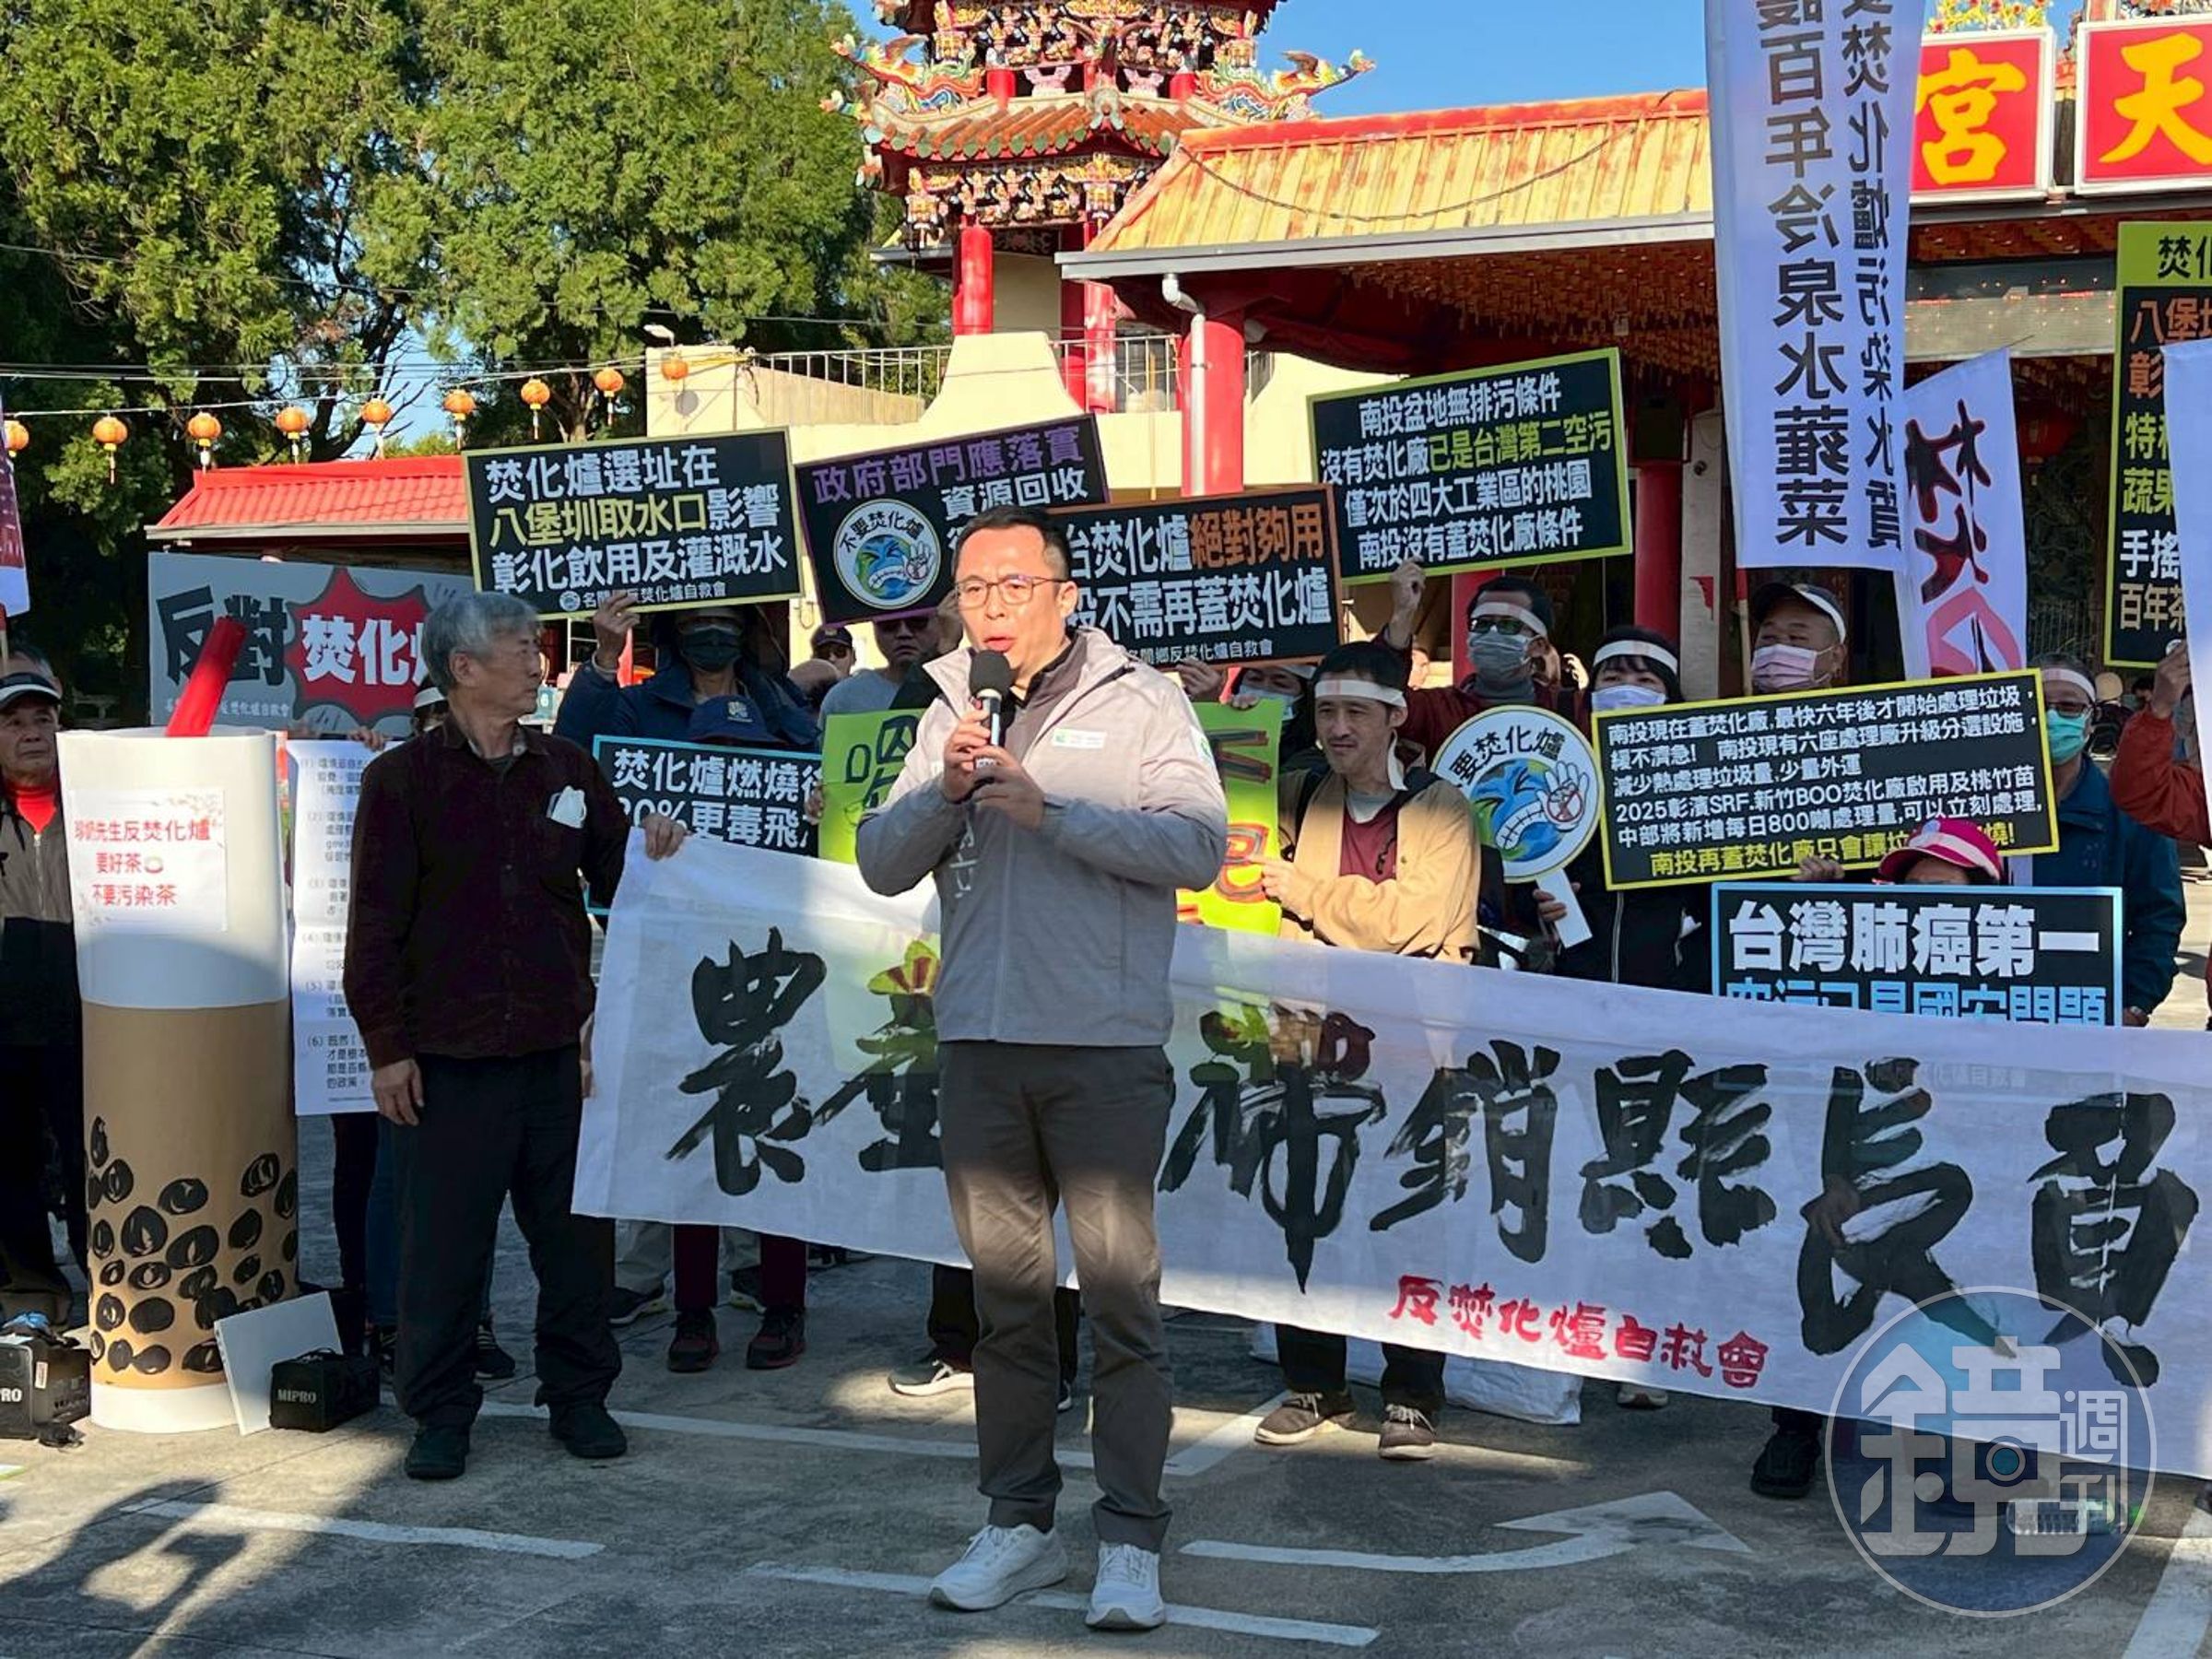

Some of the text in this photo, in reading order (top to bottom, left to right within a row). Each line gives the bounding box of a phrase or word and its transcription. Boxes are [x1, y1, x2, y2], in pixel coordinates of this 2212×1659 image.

[1359, 371, 1562, 440] 南投盆地無排污條件
[485, 444, 719, 504] 焚化爐選址在
[811, 425, 1084, 504] 政府部門應落實
[1320, 411, 1611, 486] 沒有焚化廠已是台灣第二空污
[489, 483, 780, 547] 八堡圳取水口影響
[940, 465, 1089, 522] 資源回收
[1345, 459, 1593, 529] 僅次於四大工業區的桃園
[491, 530, 788, 594] 彰化飲用及灌溉水
[839, 509, 926, 554] 不要焚化爐
[1358, 505, 1584, 571] 南投沒有蓋焚化廠條件
[582, 581, 727, 609] 名間反焚化爐自救會
[1449, 724, 1566, 786] 要焚化爐
[617, 795, 809, 848] 0%更毒飛
[92, 883, 178, 907] 不要污染茶
[1728, 899, 2100, 978] 台灣肺癌第一
[1389, 1274, 1770, 1389] 反焚化爐自救會
[0, 1387, 23, 1403] RO
